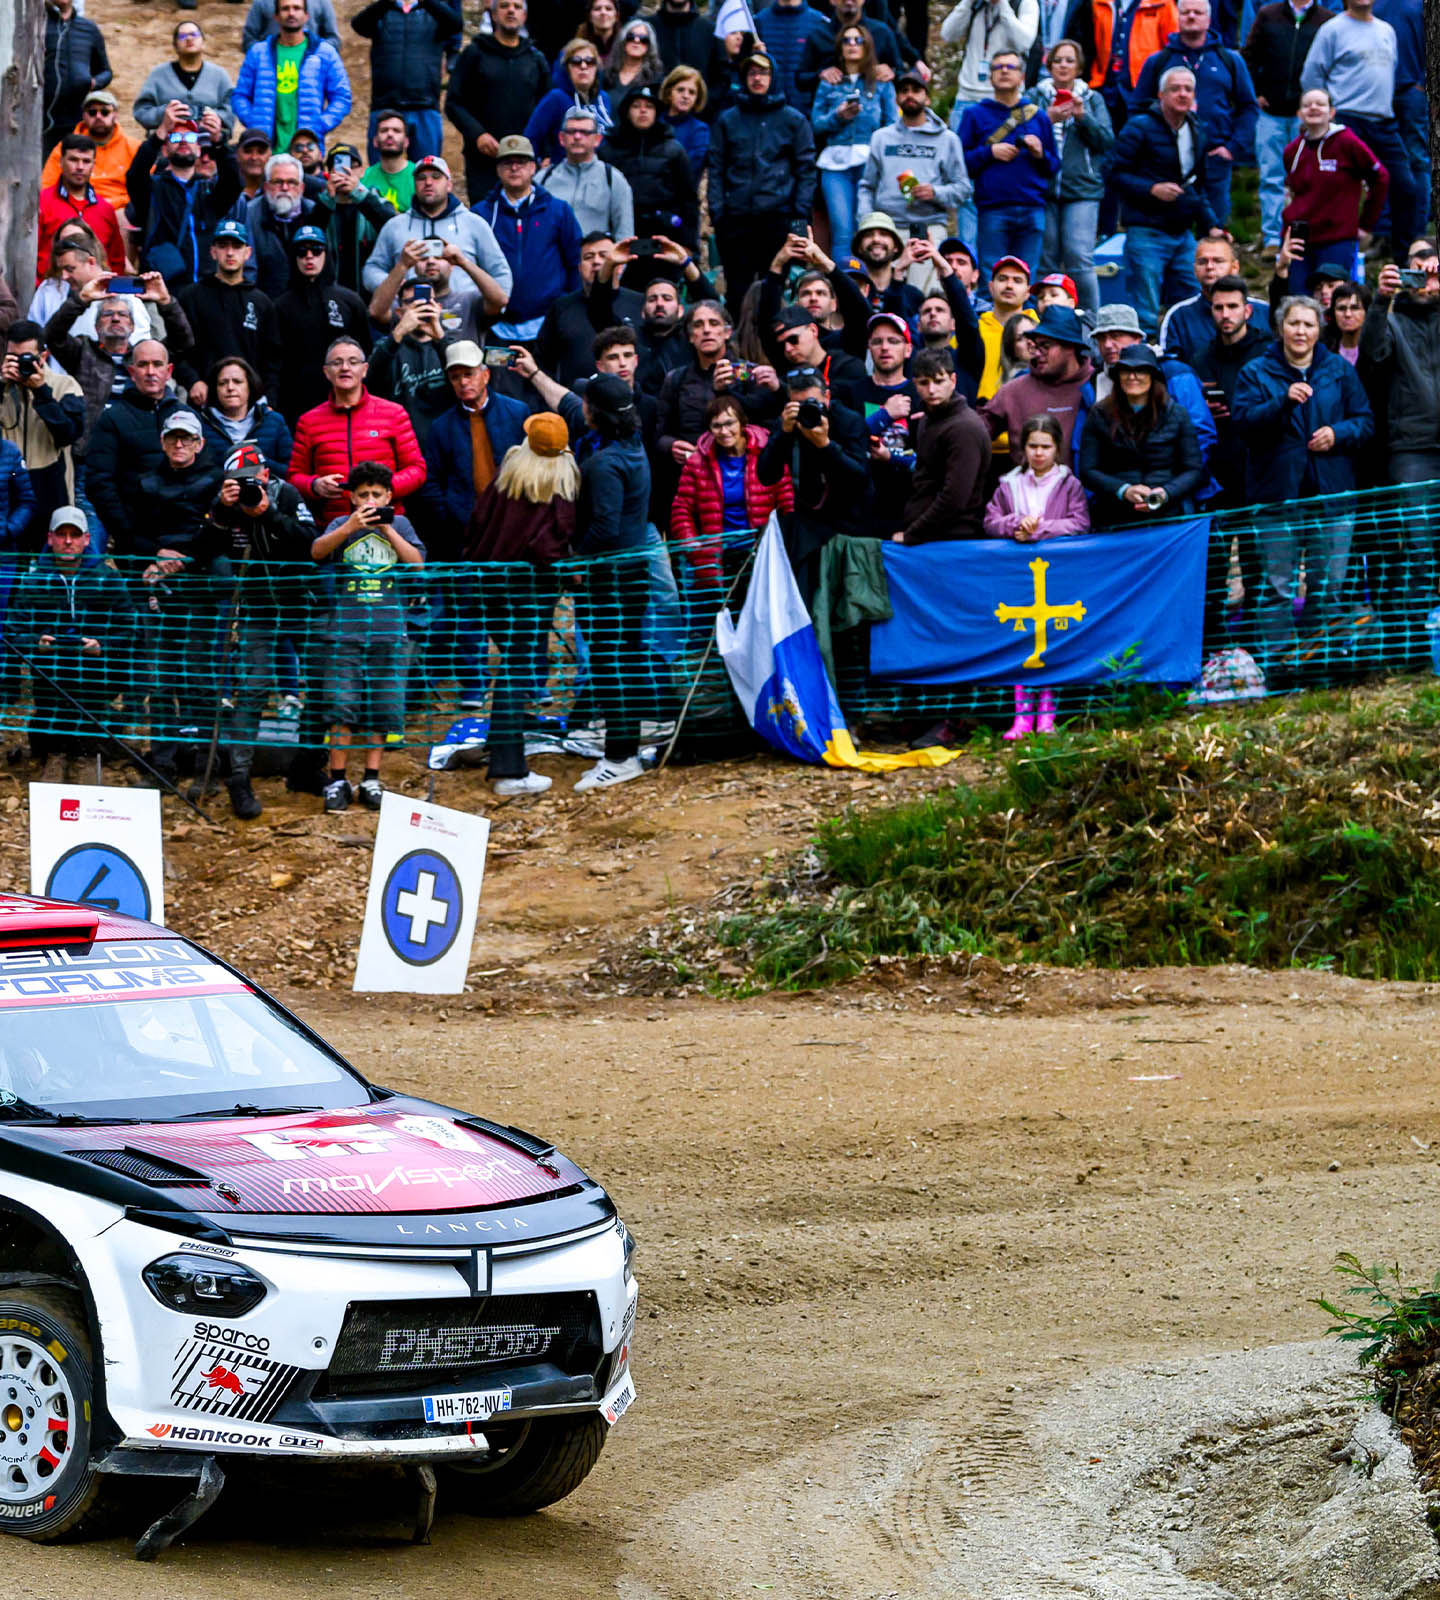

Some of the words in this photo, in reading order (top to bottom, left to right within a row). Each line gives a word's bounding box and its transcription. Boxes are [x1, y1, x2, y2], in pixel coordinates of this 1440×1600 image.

[396, 1217, 530, 1235] LANCIA
[178, 1241, 240, 1258] PHSPORT
[193, 1321, 271, 1352] sparco
[376, 1324, 561, 1370] PHSPORT
[436, 1395, 501, 1417] HH-762-NV
